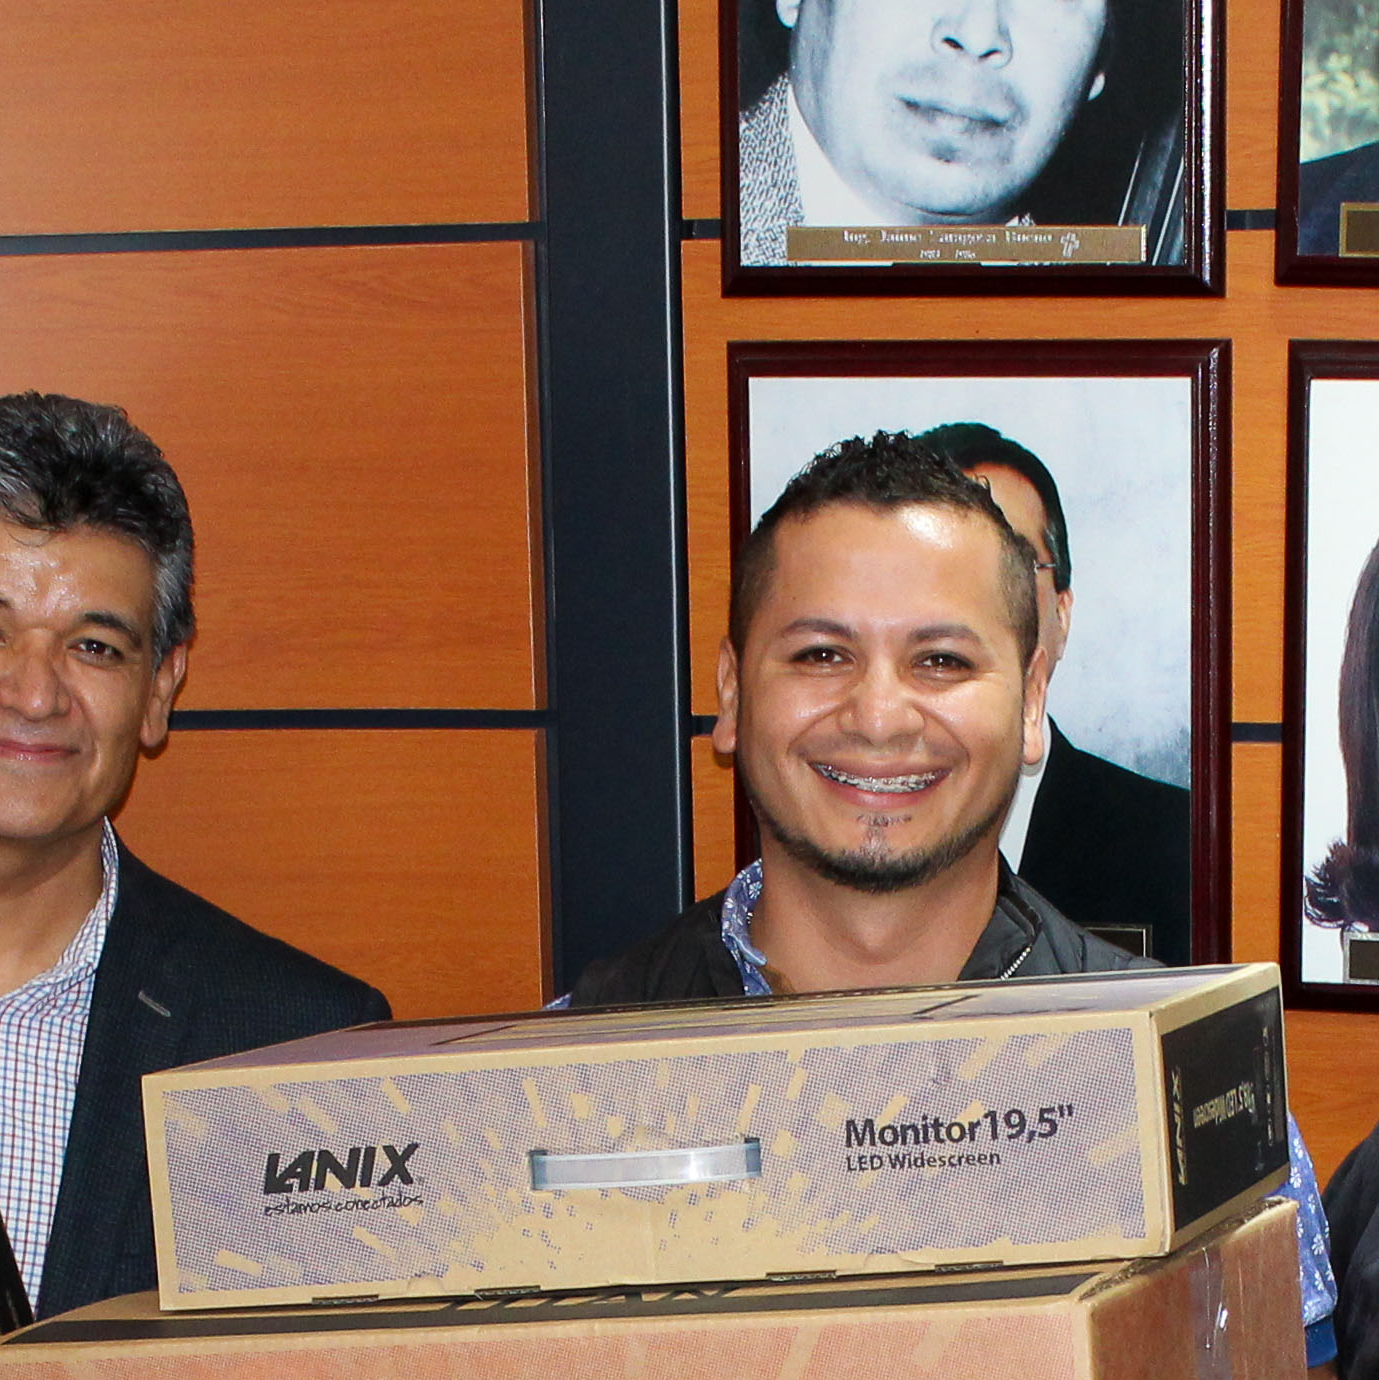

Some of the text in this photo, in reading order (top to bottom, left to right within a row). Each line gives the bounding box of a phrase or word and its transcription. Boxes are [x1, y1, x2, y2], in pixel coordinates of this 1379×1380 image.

[263, 1141, 419, 1195] LANIX
[846, 1149, 1002, 1172] LED Widescreen
